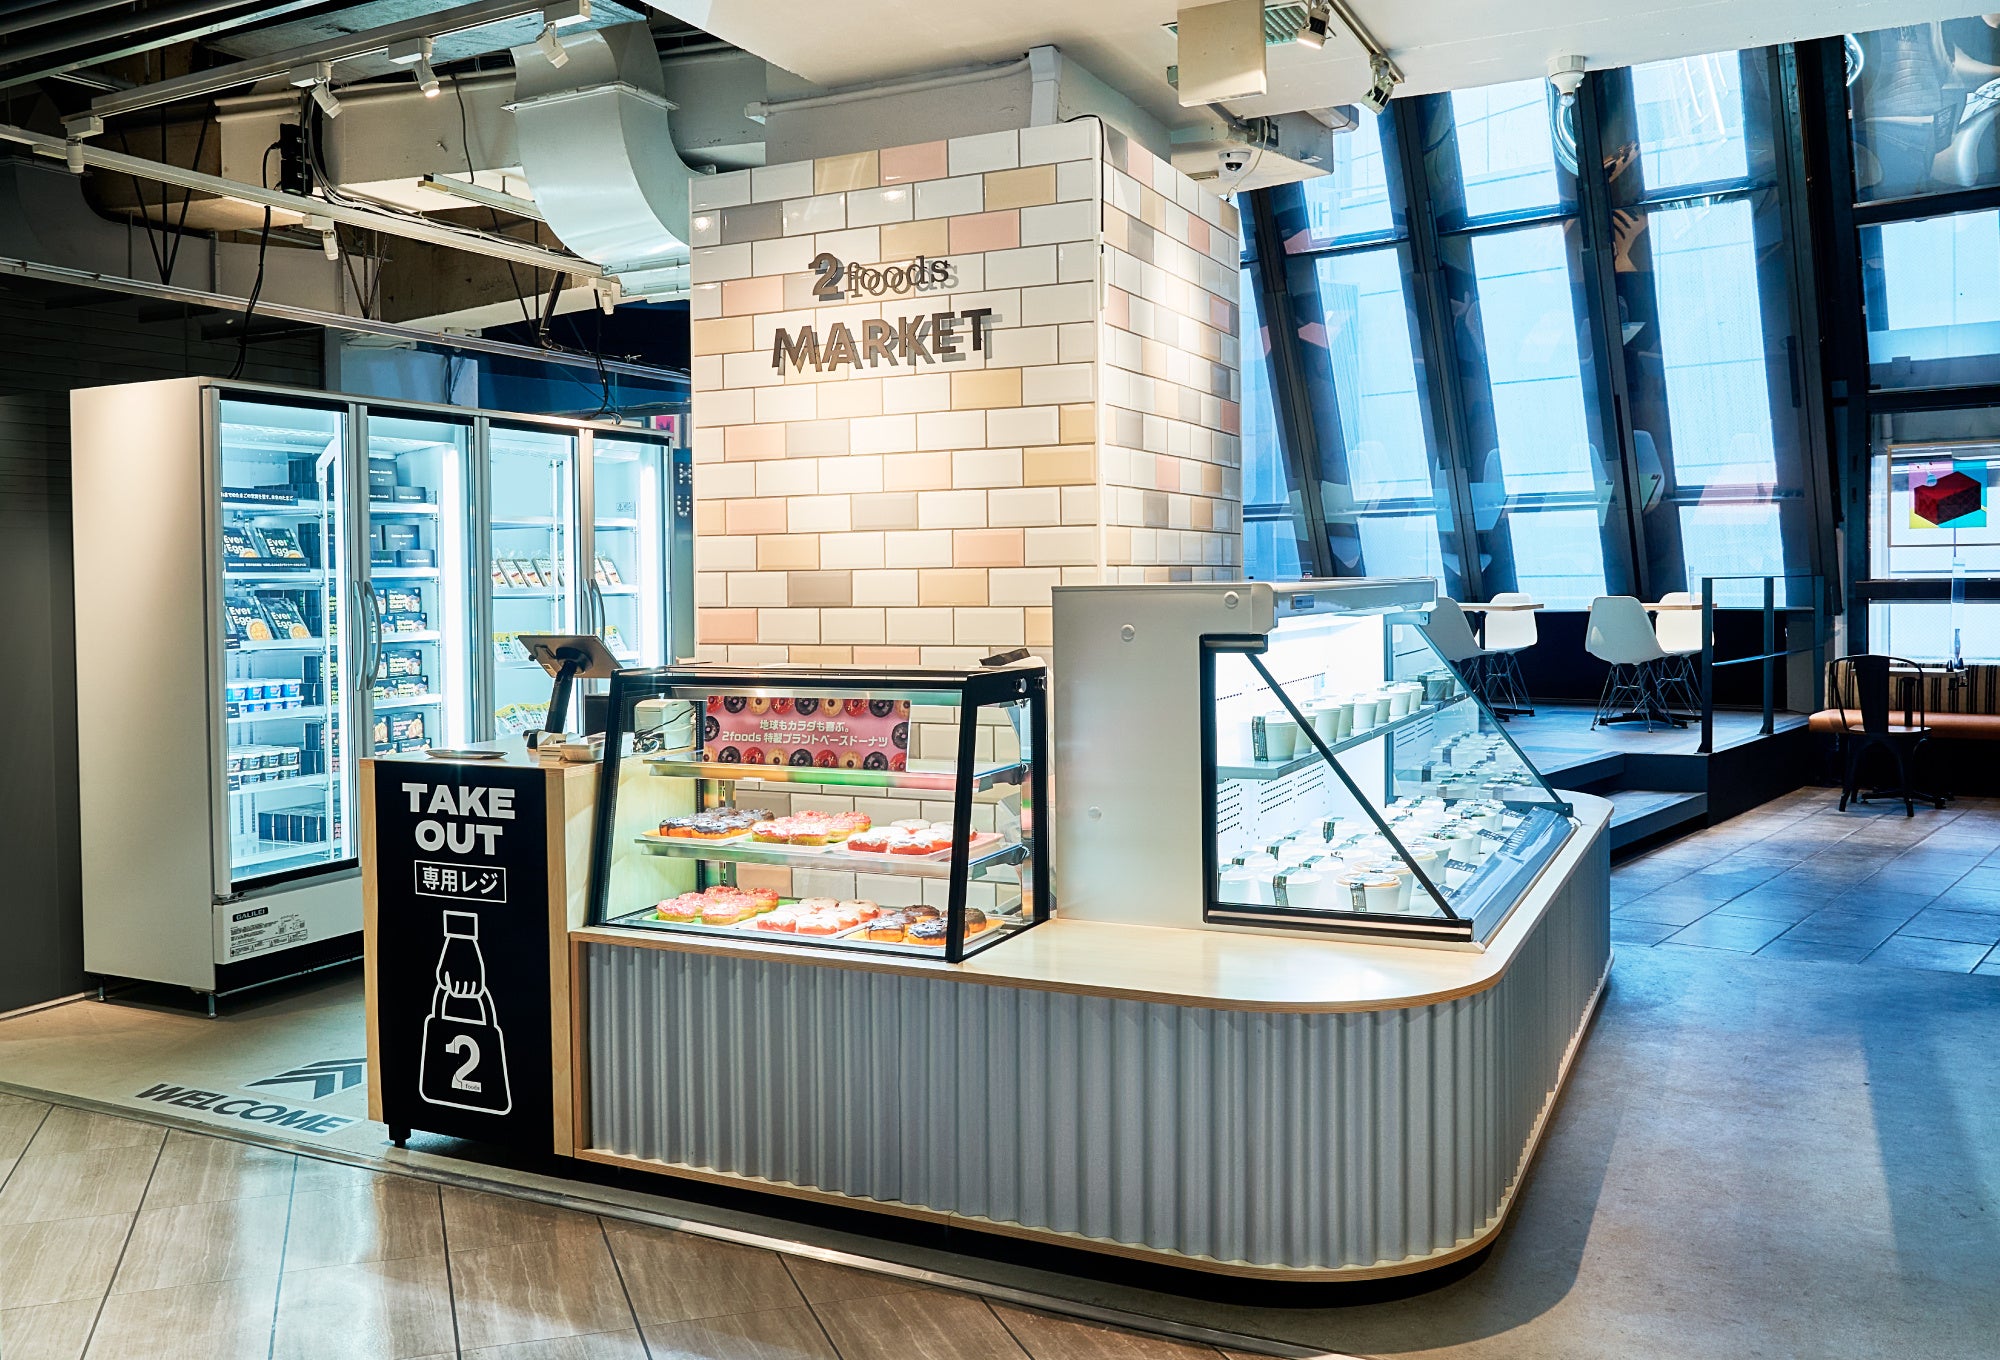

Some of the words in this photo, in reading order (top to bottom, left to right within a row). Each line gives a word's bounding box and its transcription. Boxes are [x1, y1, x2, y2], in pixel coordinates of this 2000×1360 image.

[772, 308, 992, 369] MARKET
[229, 606, 252, 615] Ever
[722, 731, 762, 742] 2foods
[402, 782, 516, 820] TAKE
[415, 820, 503, 856] OUT
[422, 866, 498, 895] 専用レジ
[135, 1083, 354, 1135] WELCOME
